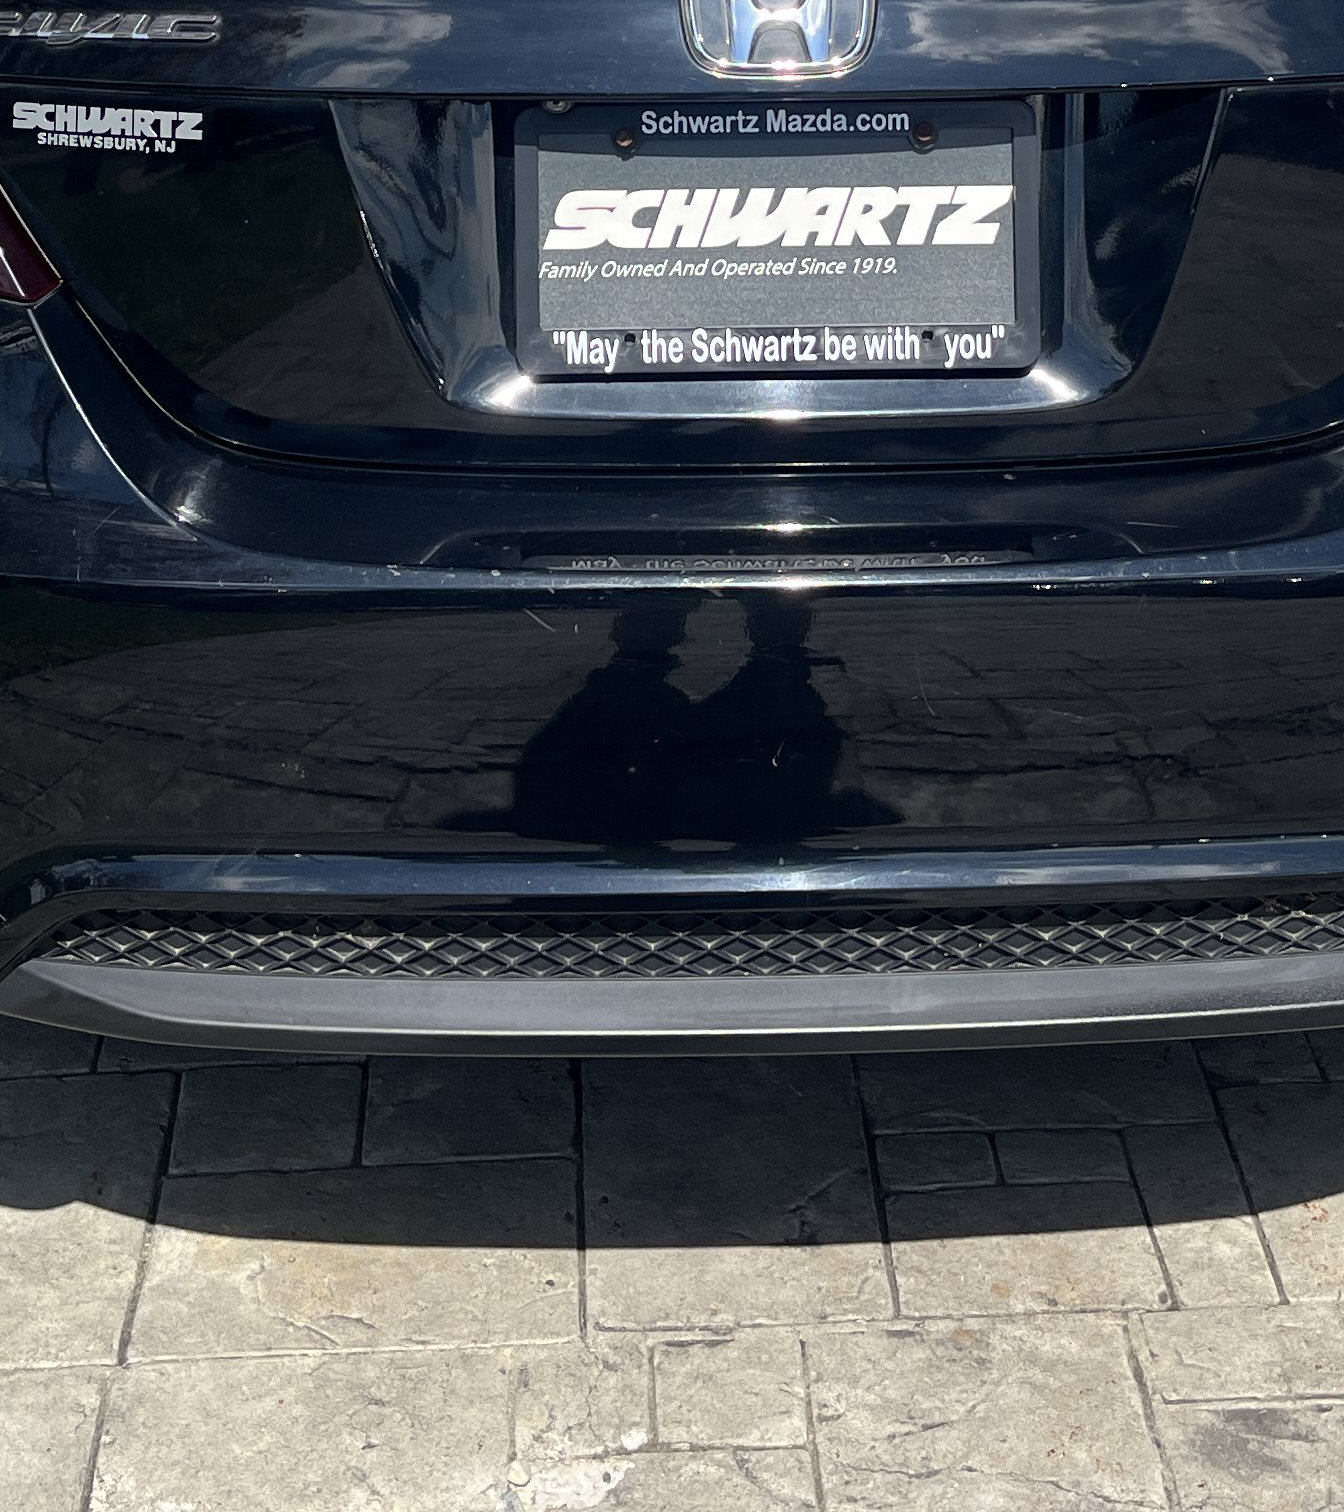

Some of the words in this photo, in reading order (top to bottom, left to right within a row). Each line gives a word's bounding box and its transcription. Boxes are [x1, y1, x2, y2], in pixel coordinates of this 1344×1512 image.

[12, 101, 203, 141] SCHWARTZ
[641, 109, 759, 134] Schwartz
[766, 108, 910, 133] Mazda.com
[37, 131, 151, 154] SHREWSBURY,
[154, 139, 176, 154] NJ
[542, 185, 1014, 251] SCHWARTZ
[539, 259, 599, 283] Family
[600, 259, 668, 278] Owned
[669, 258, 709, 277] And
[711, 257, 797, 282] Operated
[798, 257, 847, 276] Since
[852, 257, 898, 275] 1919.
[552, 330, 619, 373] "May
[641, 328, 684, 364] the
[691, 327, 818, 363] Schwartz
[824, 326, 857, 361] be
[863, 325, 920, 361] with
[944, 324, 1005, 369] you"
